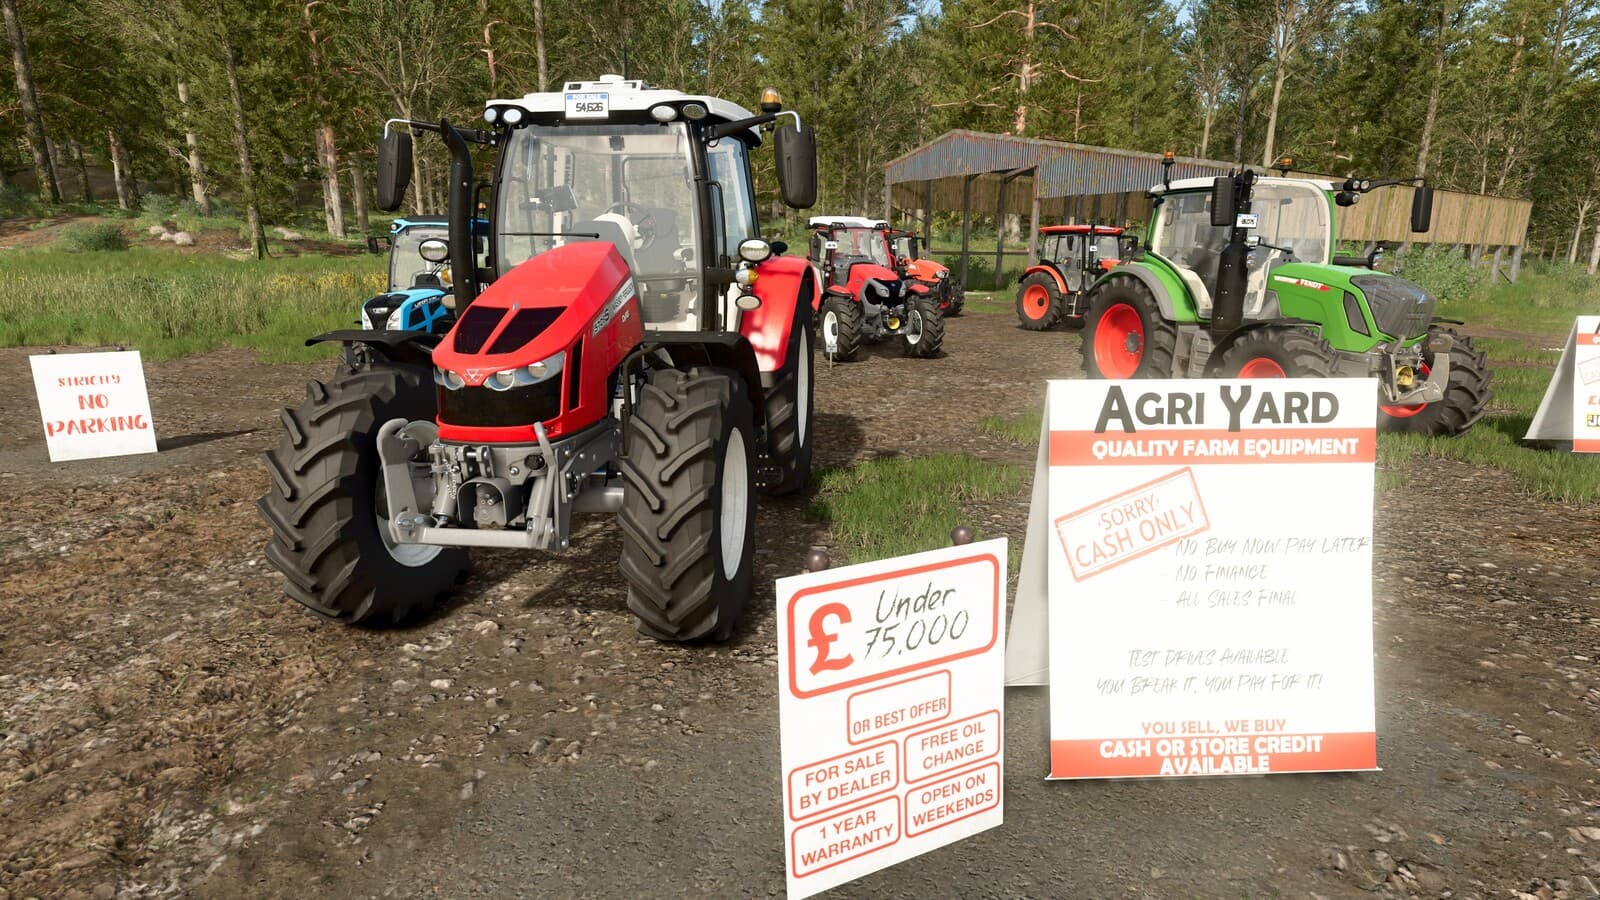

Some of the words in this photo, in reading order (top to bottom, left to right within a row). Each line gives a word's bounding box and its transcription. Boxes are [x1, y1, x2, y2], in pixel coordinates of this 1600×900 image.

[78, 393, 109, 410] NO
[46, 414, 148, 437] PARKING
[1092, 440, 1178, 461] QUALITY
[1183, 439, 1239, 457] FARM
[1244, 438, 1360, 457] EQUIPMENT
[1075, 527, 1134, 568] CASH
[1138, 501, 1198, 542] ONLY
[1175, 538, 1198, 556] NO
[1205, 538, 1237, 555] BUY
[1241, 537, 1280, 555] NOW
[1285, 537, 1316, 555] PAY
[1321, 536, 1371, 553] LATER
[1175, 564, 1198, 582] NO
[1204, 564, 1269, 581] FINANCE
[875, 582, 956, 624] Under
[1175, 591, 1200, 607] ALL
[1207, 590, 1253, 608] SALES
[1257, 590, 1297, 608] FINAL
[807, 602, 854, 676] £
[1127, 648, 1161, 668] TEST
[1164, 649, 1217, 666] DRIVES
[1218, 647, 1290, 665] AVAILABLE
[1096, 676, 1125, 695] YOU
[1129, 675, 1178, 695] BREAK
[1203, 674, 1233, 693] YOU
[1237, 674, 1266, 692] PAY
[852, 719, 871, 736] OR
[874, 708, 907, 729] BEST
[909, 697, 948, 719] OFFER
[1141, 722, 1176, 735] YOU
[1181, 721, 1221, 735] SELL,
[1224, 720, 1250, 733] WE
[1254, 719, 1288, 732] BUY
[920, 728, 959, 751] FREE
[962, 721, 987, 739] OIL
[1099, 740, 1151, 759] CASH
[1155, 739, 1186, 757] OR
[1190, 738, 1251, 755] STORE
[1253, 736, 1324, 754] CREDIT
[804, 765, 841, 787] FOR
[844, 750, 886, 776] SALE
[922, 739, 986, 770] CHANGE
[1158, 755, 1271, 776] AVAILABLE
[798, 791, 823, 810] BY
[827, 769, 892, 800] DEALER
[921, 780, 962, 805] OPEN
[964, 773, 987, 790] ON
[912, 788, 994, 828] WEEKENDS
[819, 826, 828, 840] 1
[832, 810, 877, 836] YEAR
[800, 823, 895, 867] WARRANTY
